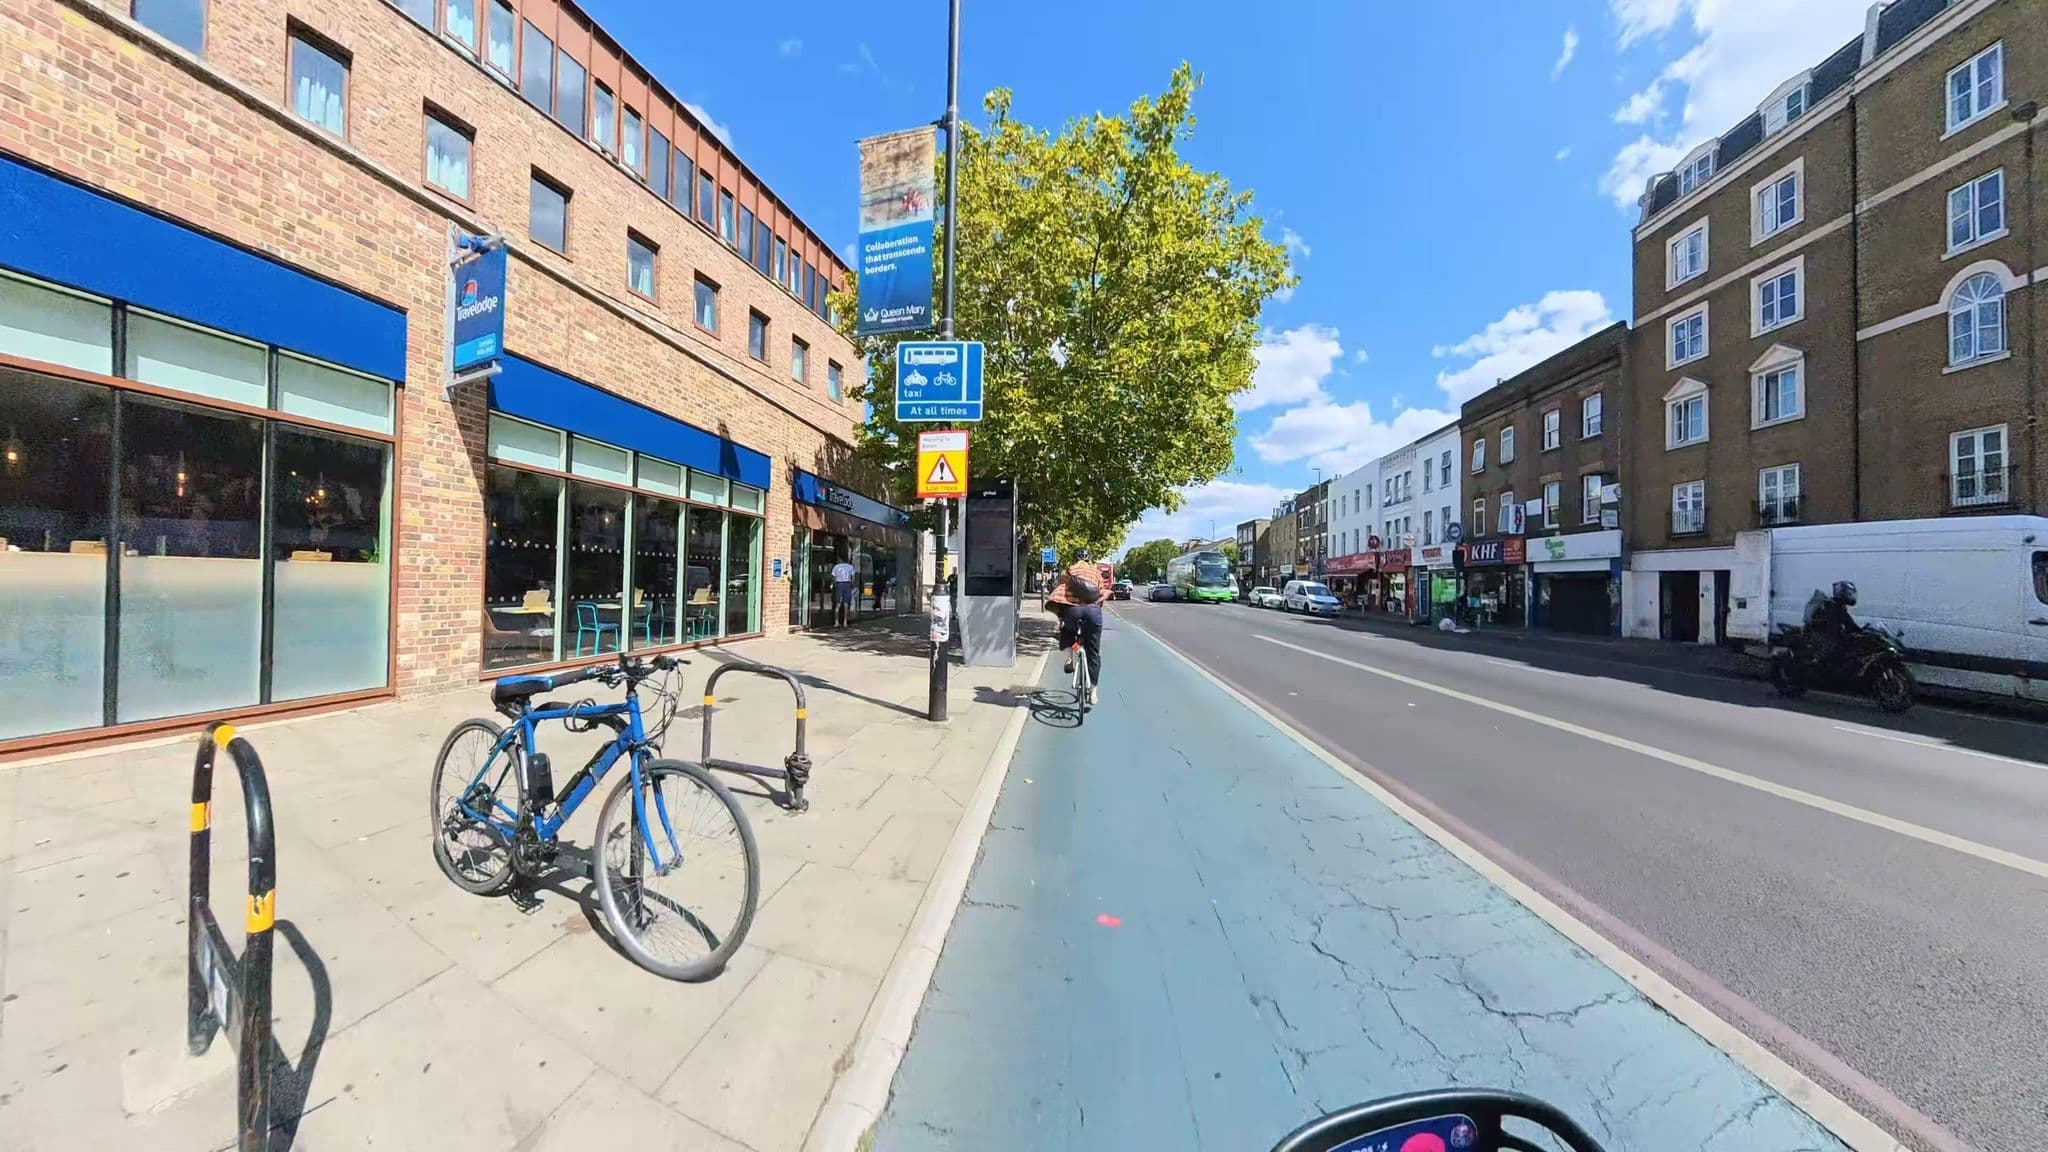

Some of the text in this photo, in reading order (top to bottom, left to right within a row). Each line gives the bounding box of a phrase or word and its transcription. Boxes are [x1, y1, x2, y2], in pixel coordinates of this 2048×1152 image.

[865, 235, 919, 252] Collaboration
[865, 245, 926, 264] that transcends
[864, 263, 897, 275] borders.
[456, 295, 498, 321] Travelodge
[880, 307, 905, 318] Queen
[906, 304, 925, 315] Mary
[903, 388, 922, 398] taxi
[910, 406, 968, 415] At all times
